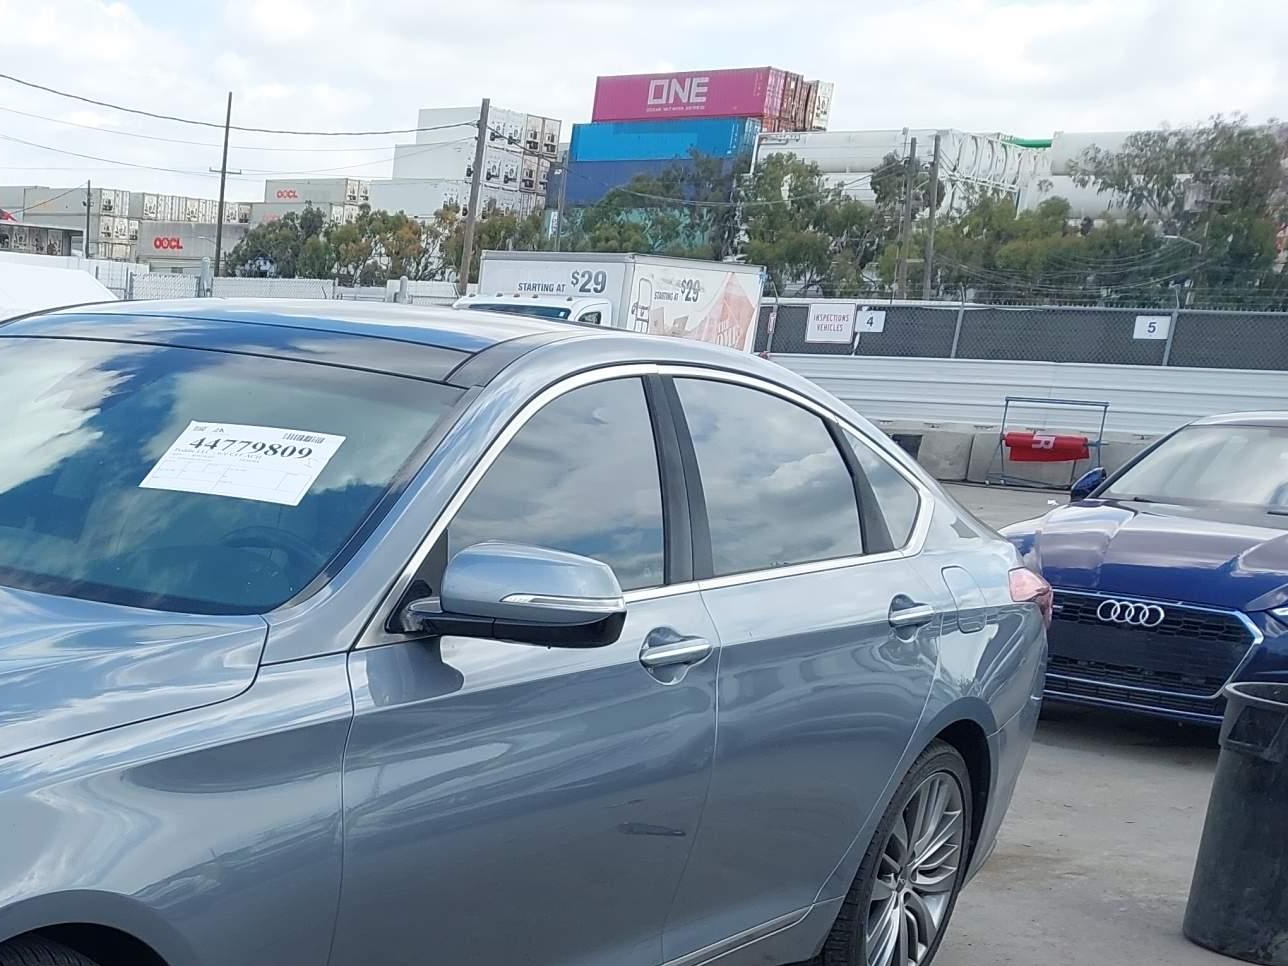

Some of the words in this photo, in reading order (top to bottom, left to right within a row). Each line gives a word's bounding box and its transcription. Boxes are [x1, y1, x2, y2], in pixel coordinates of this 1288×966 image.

[648, 76, 710, 105] ONE
[276, 190, 298, 199] OOCL
[153, 236, 184, 250] OOCL
[518, 282, 555, 292] STARTING
[556, 284, 567, 293] AT
[571, 269, 608, 294] $29
[680, 279, 701, 302] $29
[813, 314, 849, 322] INSPECTIONS
[866, 315, 875, 328] 4
[817, 323, 844, 332] VEHICLES
[1147, 321, 1158, 334] 5
[189, 436, 313, 459] 44779809
